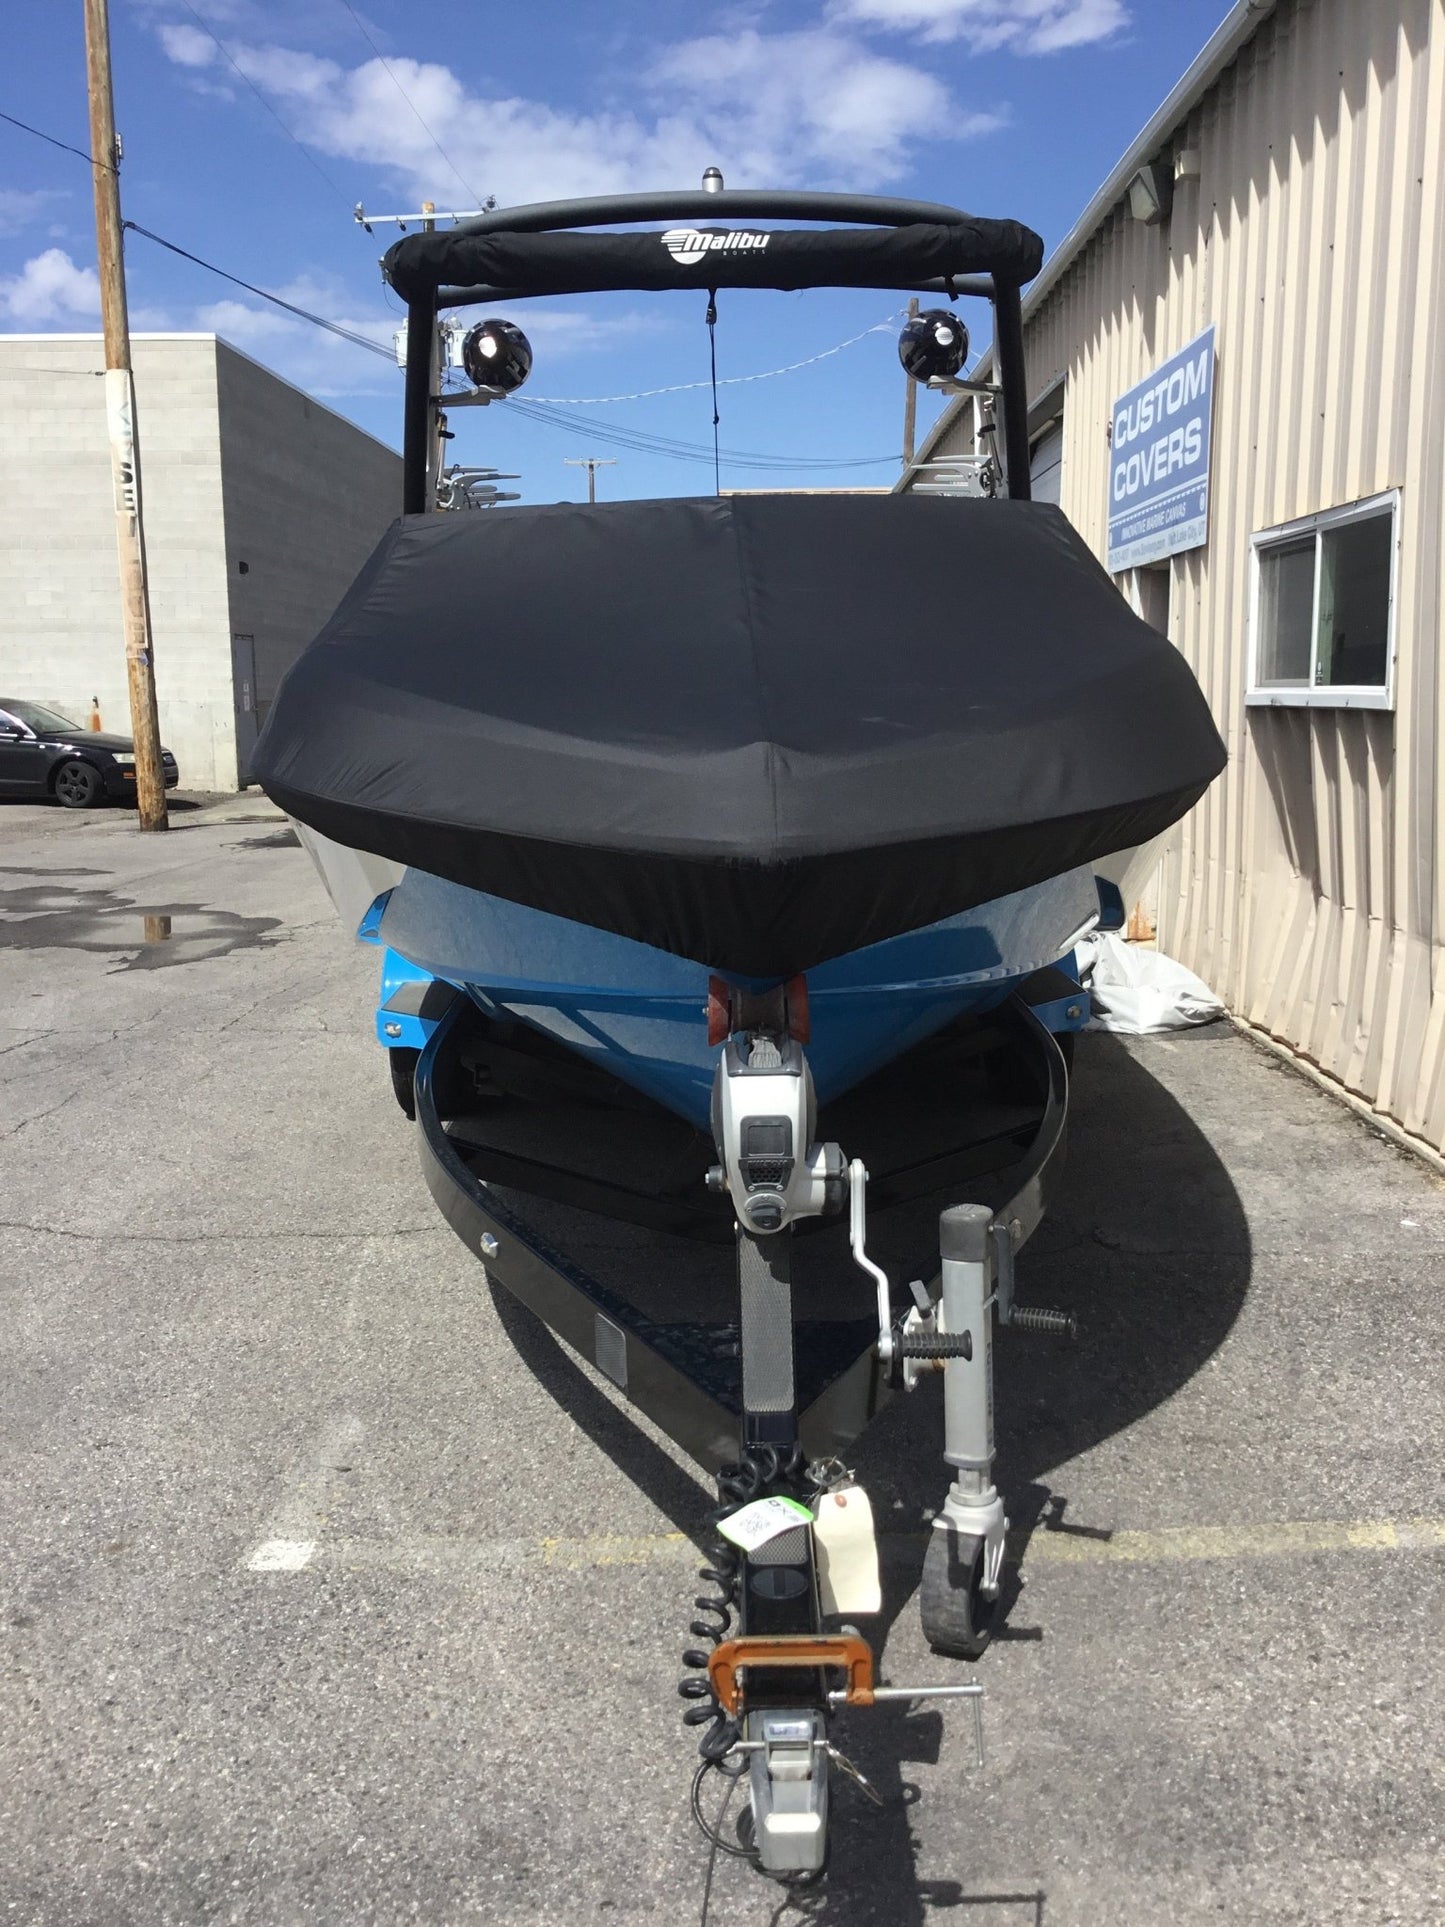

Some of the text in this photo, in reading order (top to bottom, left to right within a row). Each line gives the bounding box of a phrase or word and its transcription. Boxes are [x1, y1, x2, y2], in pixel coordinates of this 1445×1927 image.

[683, 232, 770, 251] Malibu
[1114, 349, 1208, 450] CUSTOM
[1115, 417, 1202, 501] COVERS
[1165, 502, 1186, 524] CANVAS
